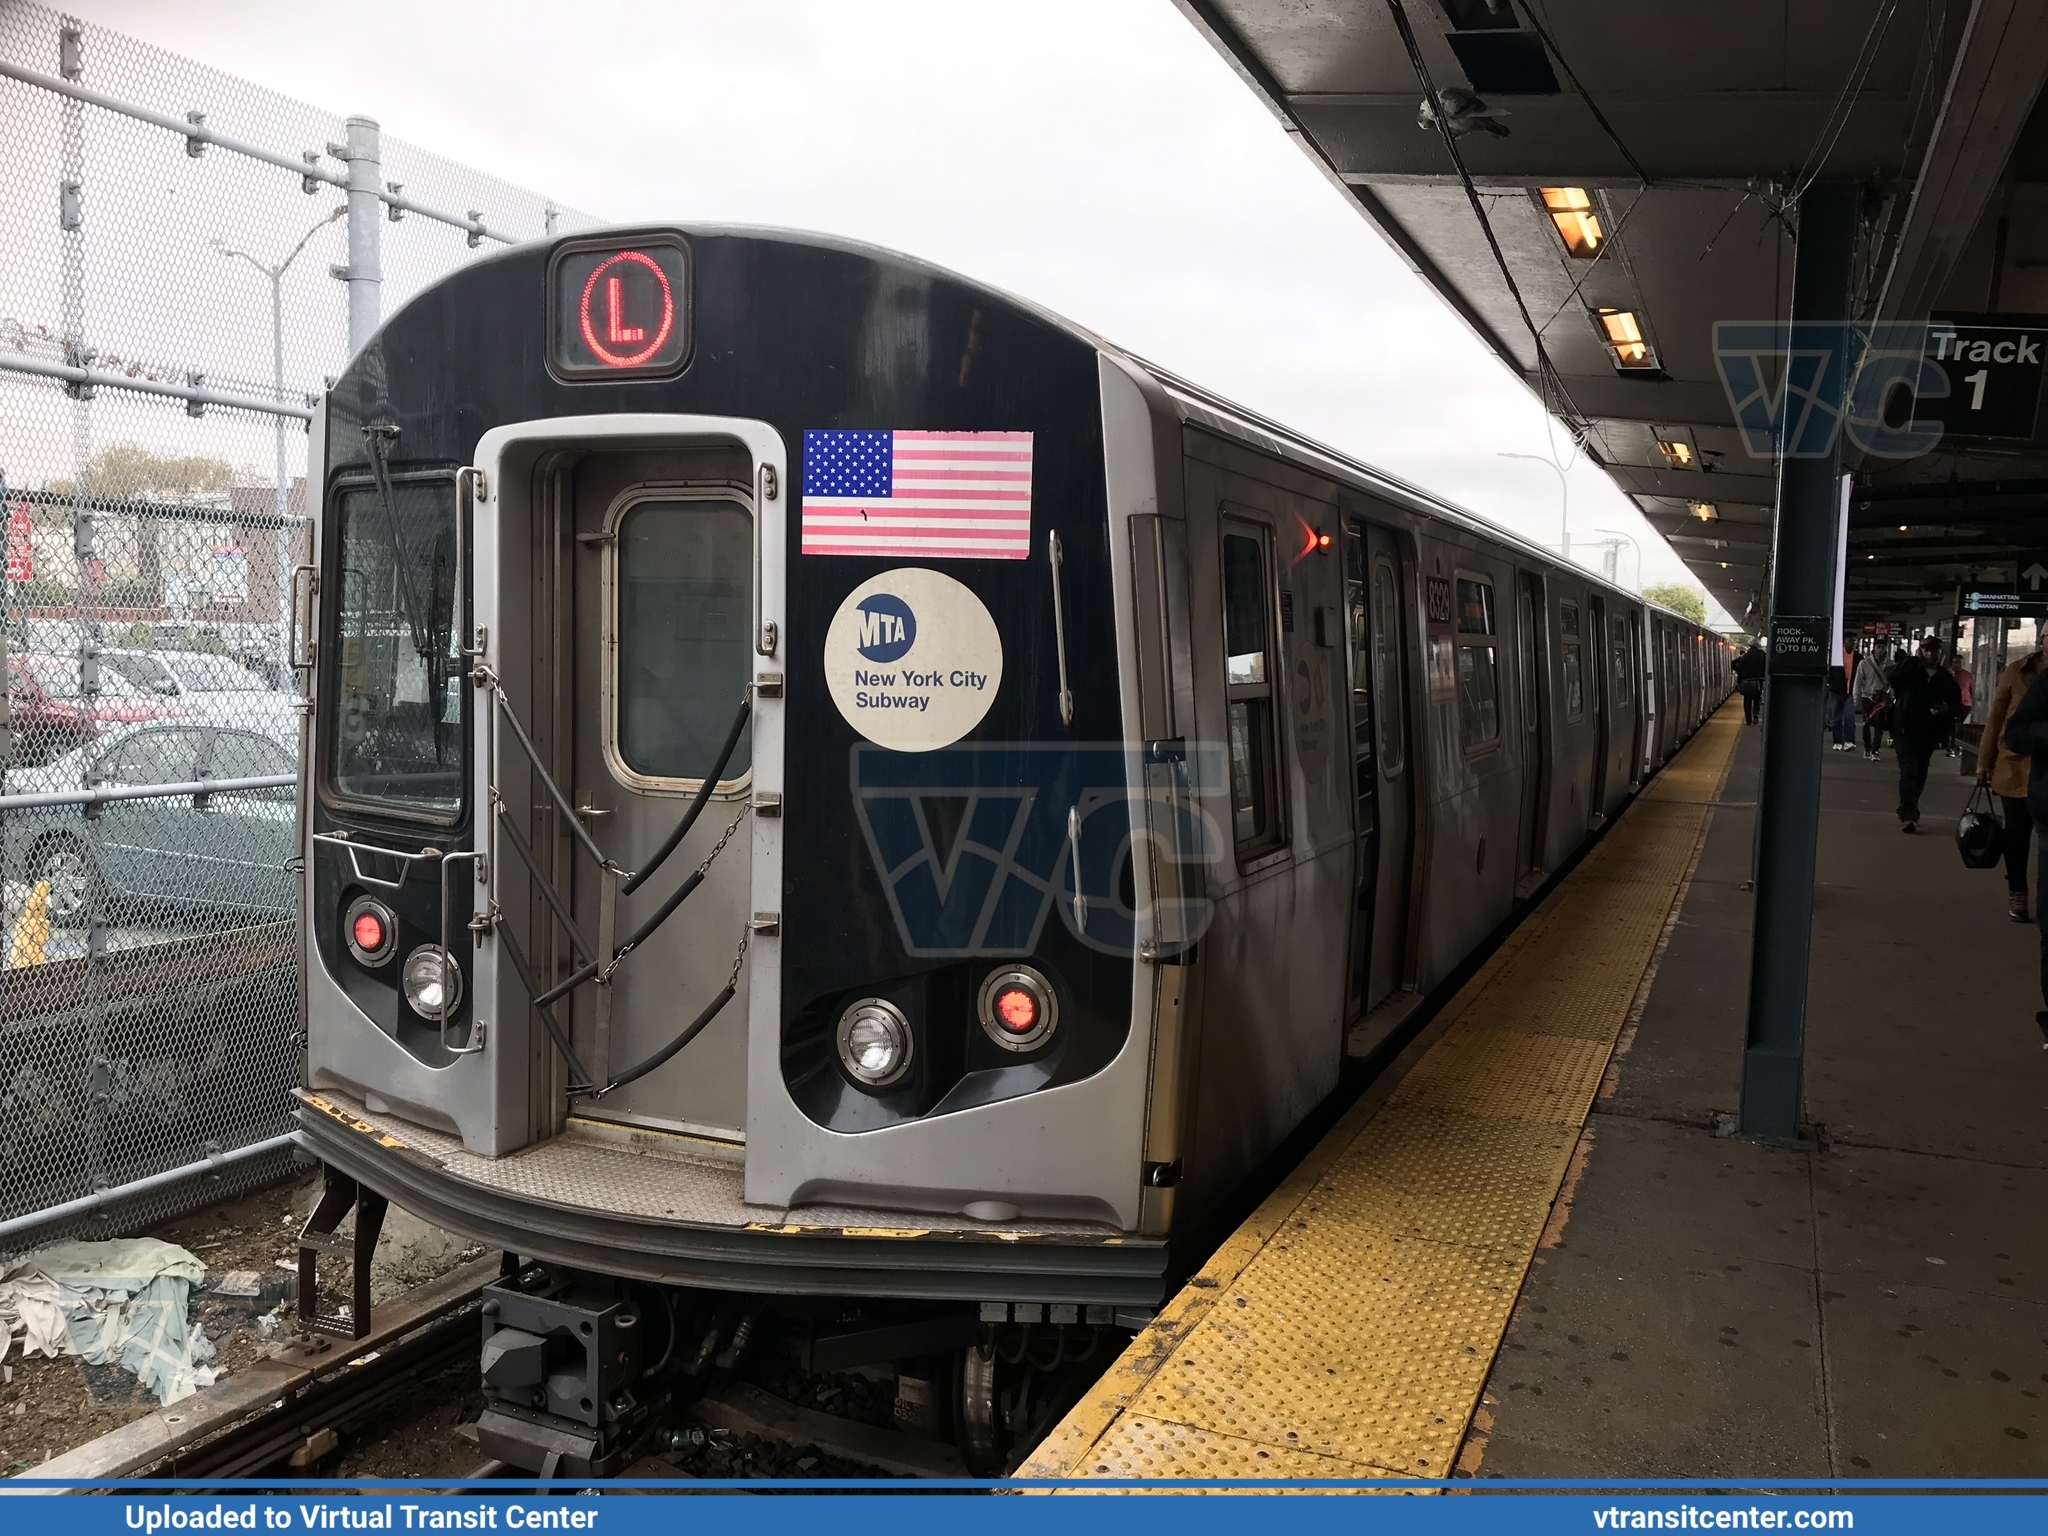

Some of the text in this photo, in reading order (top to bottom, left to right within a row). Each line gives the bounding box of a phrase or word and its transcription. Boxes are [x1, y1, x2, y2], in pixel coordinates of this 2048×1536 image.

[609, 277, 644, 342] L
[1931, 332, 2042, 364] Track
[1964, 369, 1988, 410] 1
[1429, 580, 1450, 620] 8329
[856, 609, 906, 650] MTA
[1776, 627, 1805, 636] ROCK-
[1776, 636, 1817, 645] AWAY PK.
[1787, 644, 1800, 652] TO
[1808, 645, 1820, 653] AV
[855, 670, 988, 690] New York City
[856, 692, 930, 711] Subway
